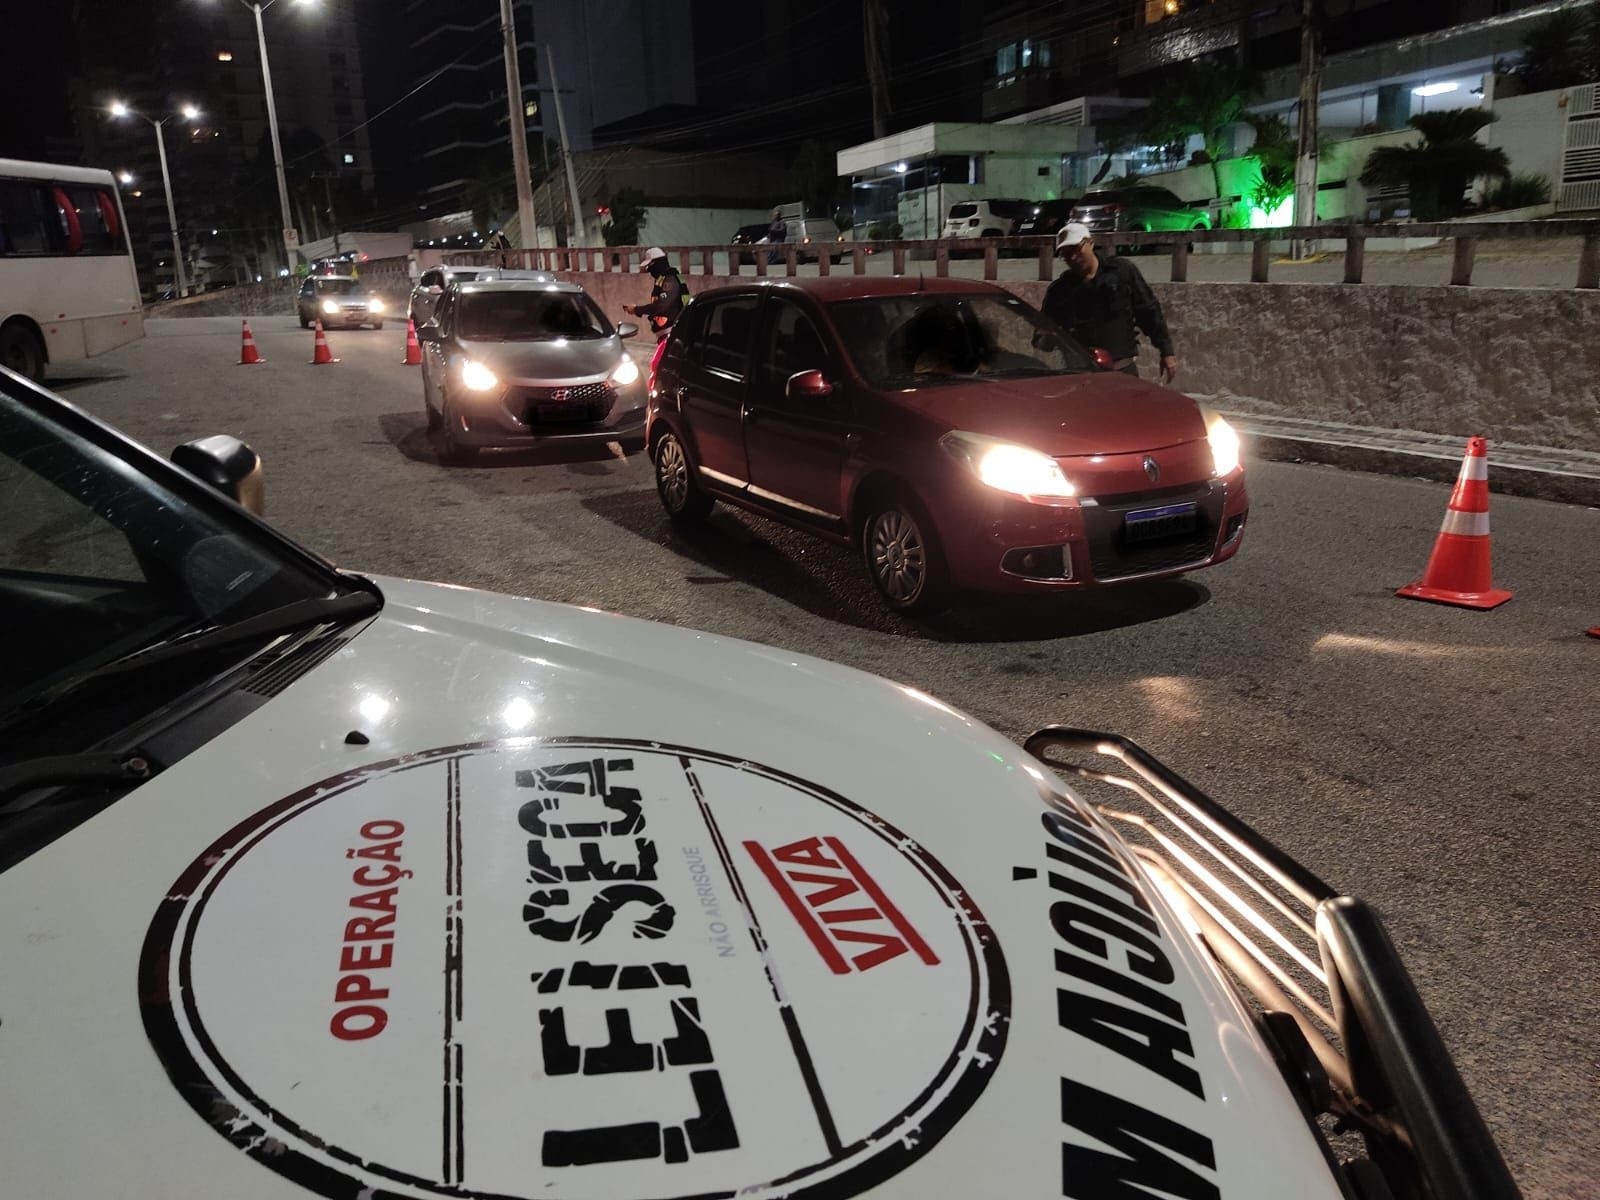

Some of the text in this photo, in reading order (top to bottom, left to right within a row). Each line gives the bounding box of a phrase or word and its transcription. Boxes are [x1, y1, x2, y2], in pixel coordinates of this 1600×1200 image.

[330, 819, 413, 1041] OPERAÇÃO
[515, 757, 740, 1167] LEI SECA
[682, 846, 737, 958] NÃO ARRISQUE
[770, 836, 910, 973] VIVA
